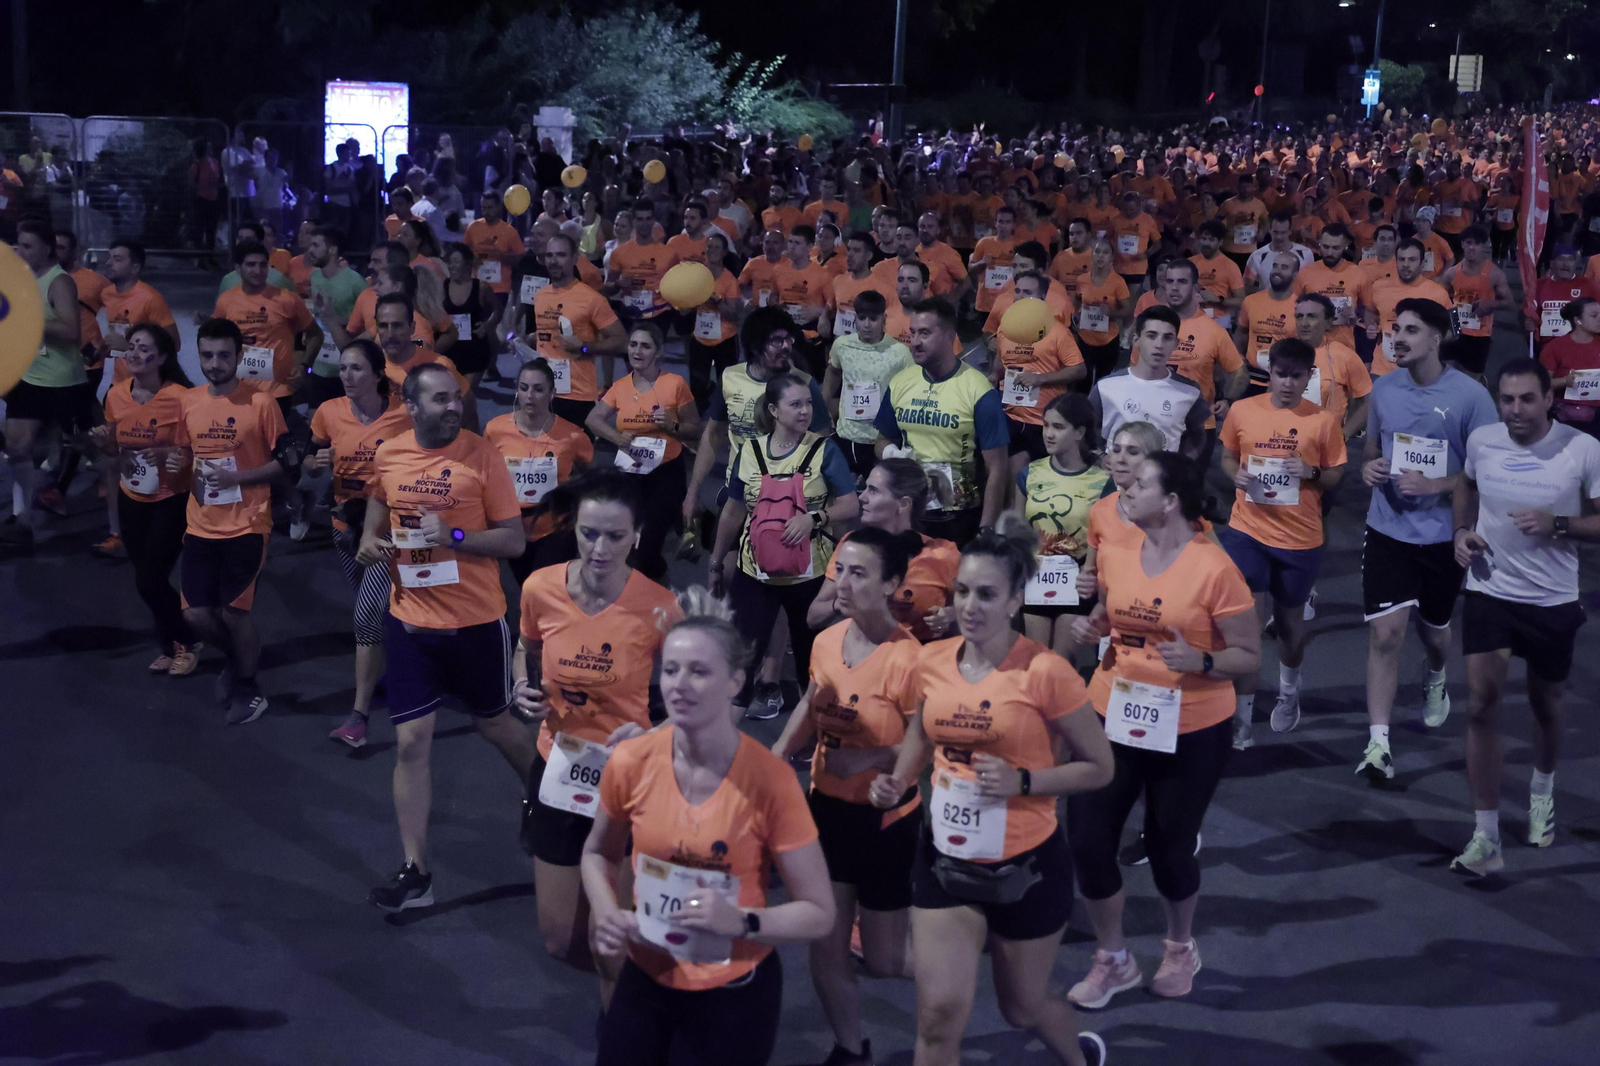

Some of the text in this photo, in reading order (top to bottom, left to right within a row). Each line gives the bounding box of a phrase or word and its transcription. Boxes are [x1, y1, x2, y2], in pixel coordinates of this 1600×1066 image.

[243, 357, 266, 369] 16810
[1577, 380, 1599, 389] 18244
[896, 408, 960, 430] BARREÑOS
[1254, 442, 1281, 450] SEVILLA
[1268, 437, 1299, 446] NOCTURNA
[629, 449, 655, 460] 14036
[1404, 450, 1436, 466] 16044
[415, 479, 452, 489] NOCTURNA
[515, 473, 547, 485] 21639
[1258, 473, 1290, 487] 16042
[397, 484, 430, 495] SEVILLA
[410, 549, 433, 563] 857
[1036, 572, 1069, 585] 14075
[1114, 608, 1143, 619] SEVILLA
[558, 658, 590, 670] SEVILLA
[575, 653, 614, 665] NOCTURNA
[1124, 702, 1159, 724] 6079
[935, 718, 969, 729] SEVILLA
[570, 763, 601, 787] 669
[943, 802, 981, 827] 6251
